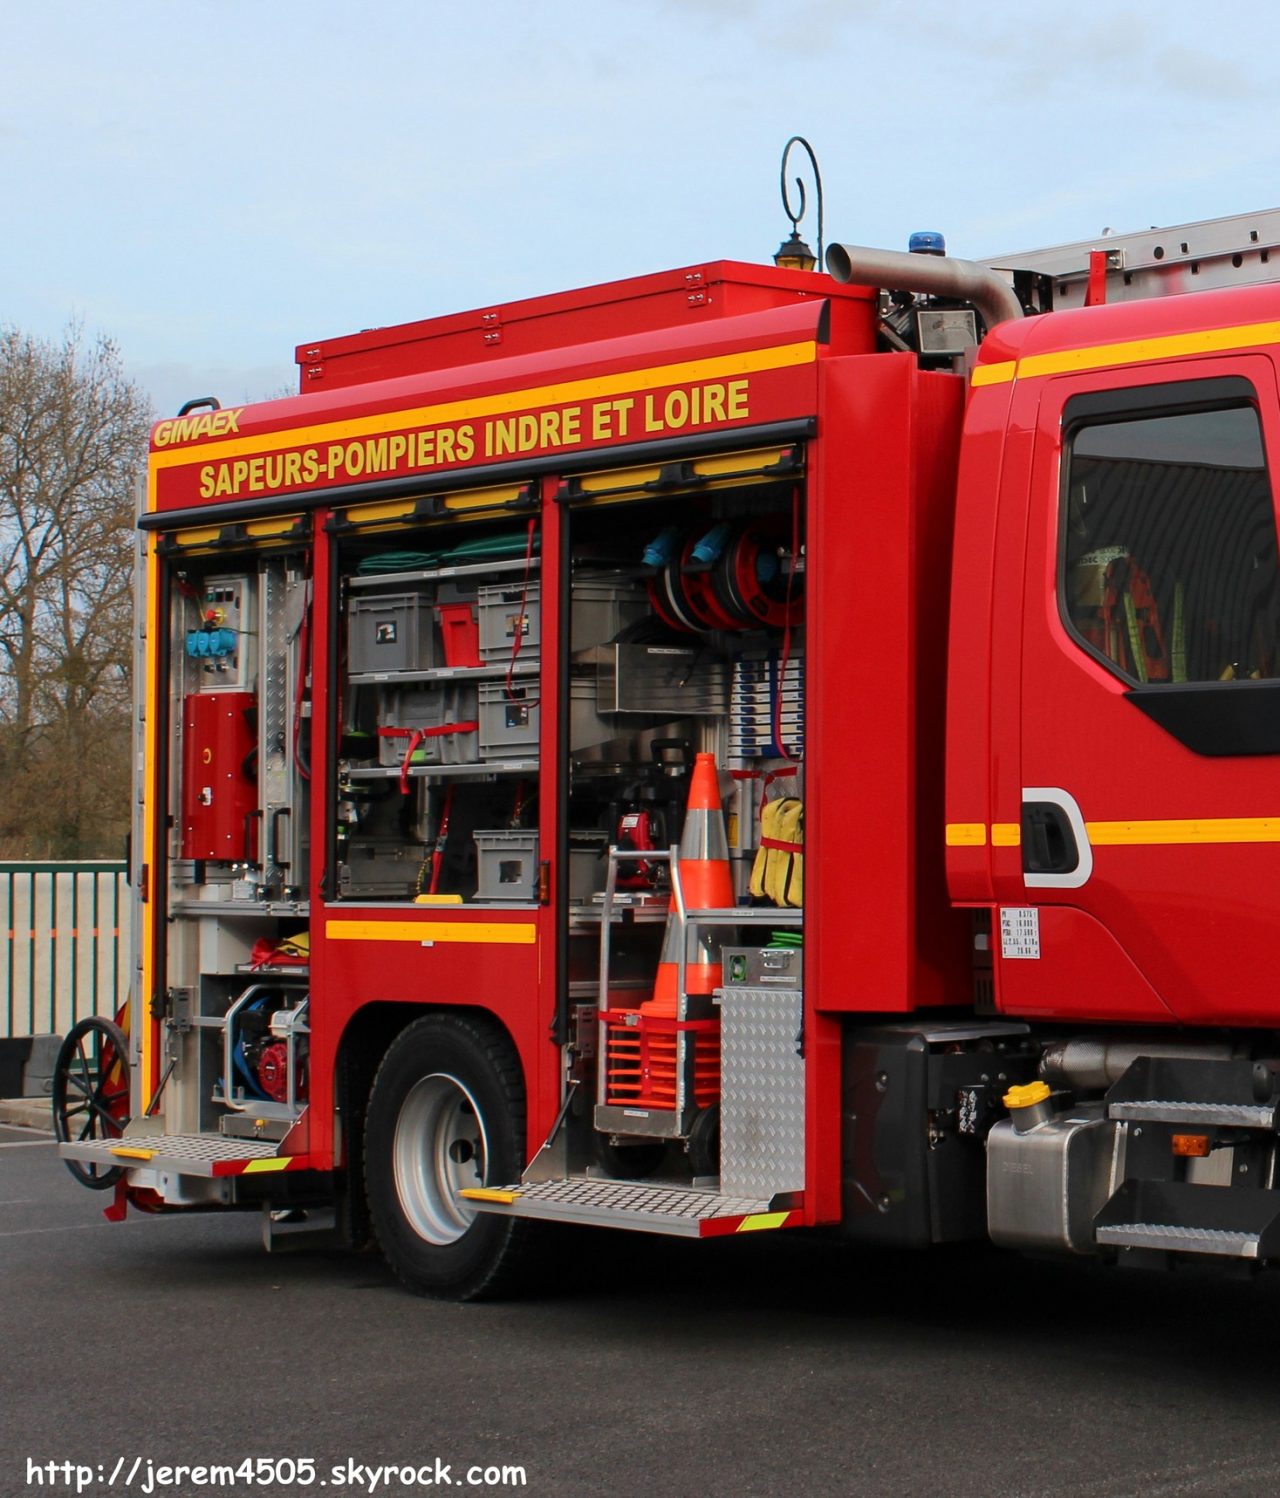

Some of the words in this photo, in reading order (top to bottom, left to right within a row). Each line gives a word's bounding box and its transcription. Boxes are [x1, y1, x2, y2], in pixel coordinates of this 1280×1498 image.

[153, 408, 244, 447] GIMAEX
[199, 425, 475, 498] SAPEURS-POMPIERS
[485, 407, 581, 457] INDRE
[592, 398, 634, 440] ET
[645, 379, 749, 432] LOIRE
